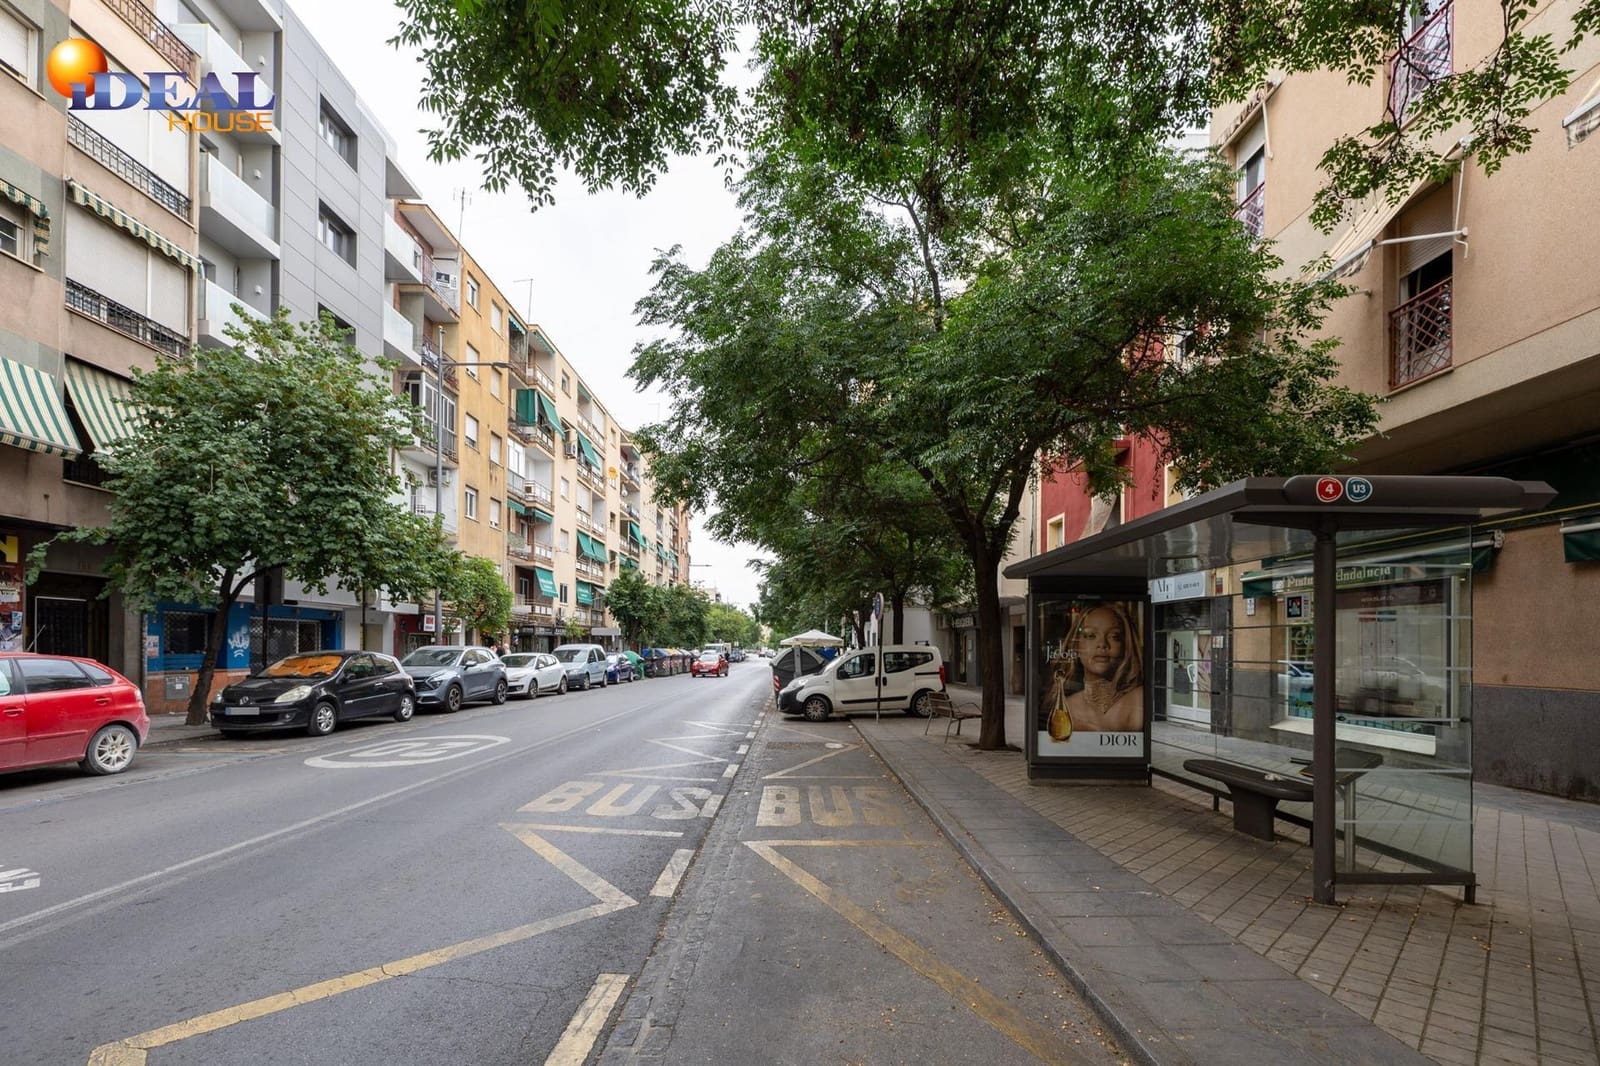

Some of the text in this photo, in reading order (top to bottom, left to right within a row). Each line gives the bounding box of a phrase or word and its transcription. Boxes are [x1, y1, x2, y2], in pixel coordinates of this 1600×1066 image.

[1324, 483, 1335, 494] 4
[1352, 484, 1367, 494] U3
[1098, 734, 1137, 747] DIOR
[515, 780, 713, 821] BUS
[755, 785, 894, 828] BUS
